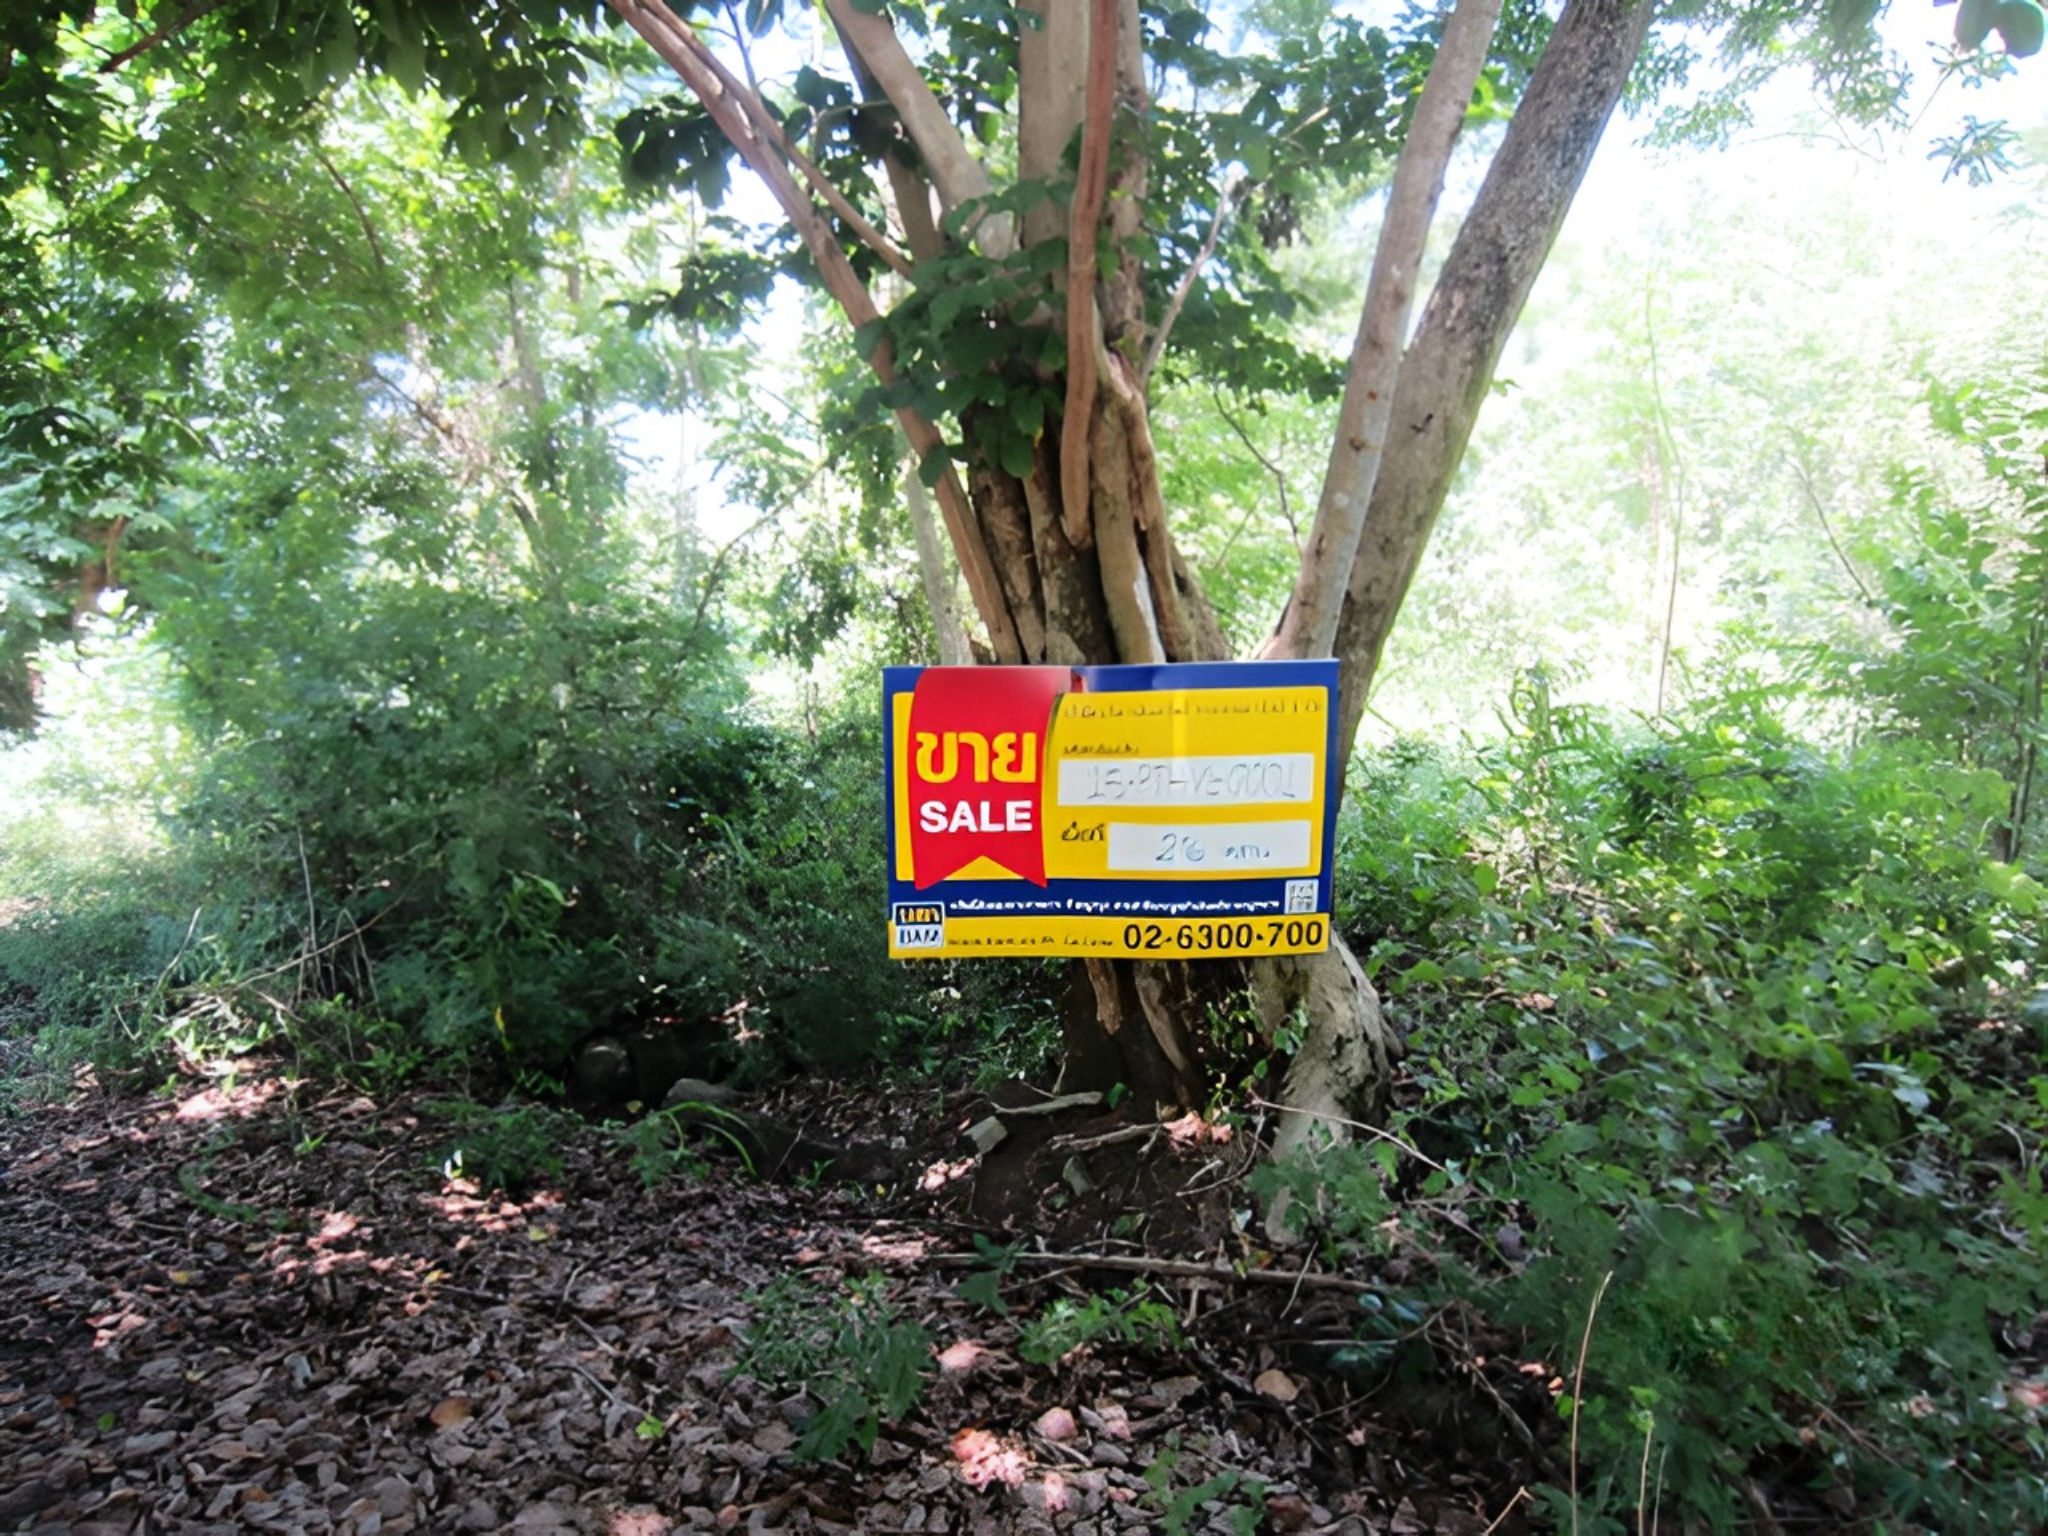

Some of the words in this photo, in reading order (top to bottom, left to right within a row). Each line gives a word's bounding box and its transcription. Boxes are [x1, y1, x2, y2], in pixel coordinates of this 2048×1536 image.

[915, 732, 1037, 784] ขาย
[919, 799, 1033, 834] SALE
[1123, 920, 1323, 950] 02-6300-700
